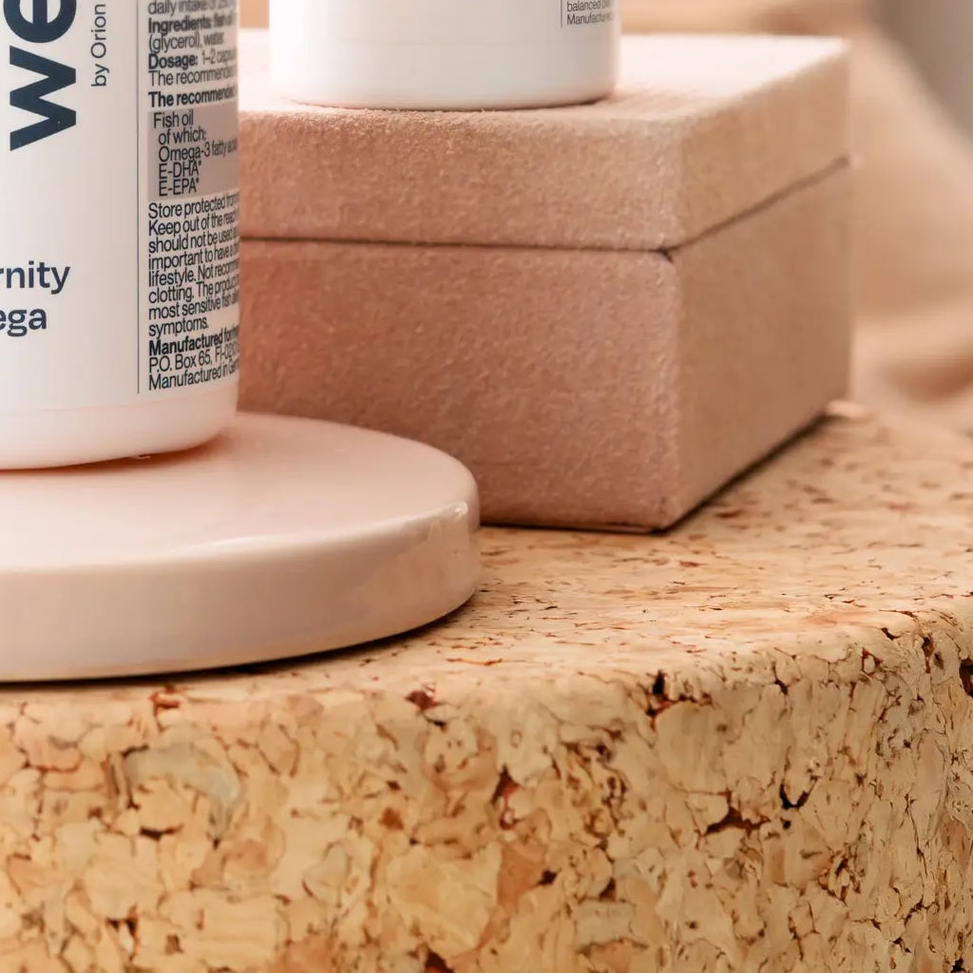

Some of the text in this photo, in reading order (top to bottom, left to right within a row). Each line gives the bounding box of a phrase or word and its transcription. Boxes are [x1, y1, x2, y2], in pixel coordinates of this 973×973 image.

[567, 0, 601, 13] balanced
[90, 4, 107, 59] Orion
[148, 53, 199, 71] Dosage:
[90, 63, 110, 87] by
[148, 70, 174, 87] The
[148, 91, 174, 108] The
[153, 109, 194, 129] Fish oil
[158, 125, 207, 145] of which:
[158, 142, 211, 163] Omega-3
[148, 196, 226, 219] Store protected
[148, 219, 182, 238] Keep
[183, 216, 200, 233] out
[201, 213, 211, 230] of
[211, 212, 223, 229] the
[148, 234, 189, 254] should
[190, 234, 207, 250] not
[207, 231, 218, 246] be
[148, 249, 204, 272] important
[205, 248, 214, 262] to
[148, 265, 214, 288] lifestyle. Not
[148, 284, 195, 304] clotting.
[195, 281, 214, 297] The
[148, 303, 180, 320] most
[181, 295, 221, 316] sensitive
[148, 317, 210, 339] symptoms.
[148, 327, 223, 357] Manufactured
[148, 356, 173, 373] P.O.
[174, 352, 198, 371] Box
[198, 349, 213, 368] 65,
[148, 364, 222, 391] Manufactured
